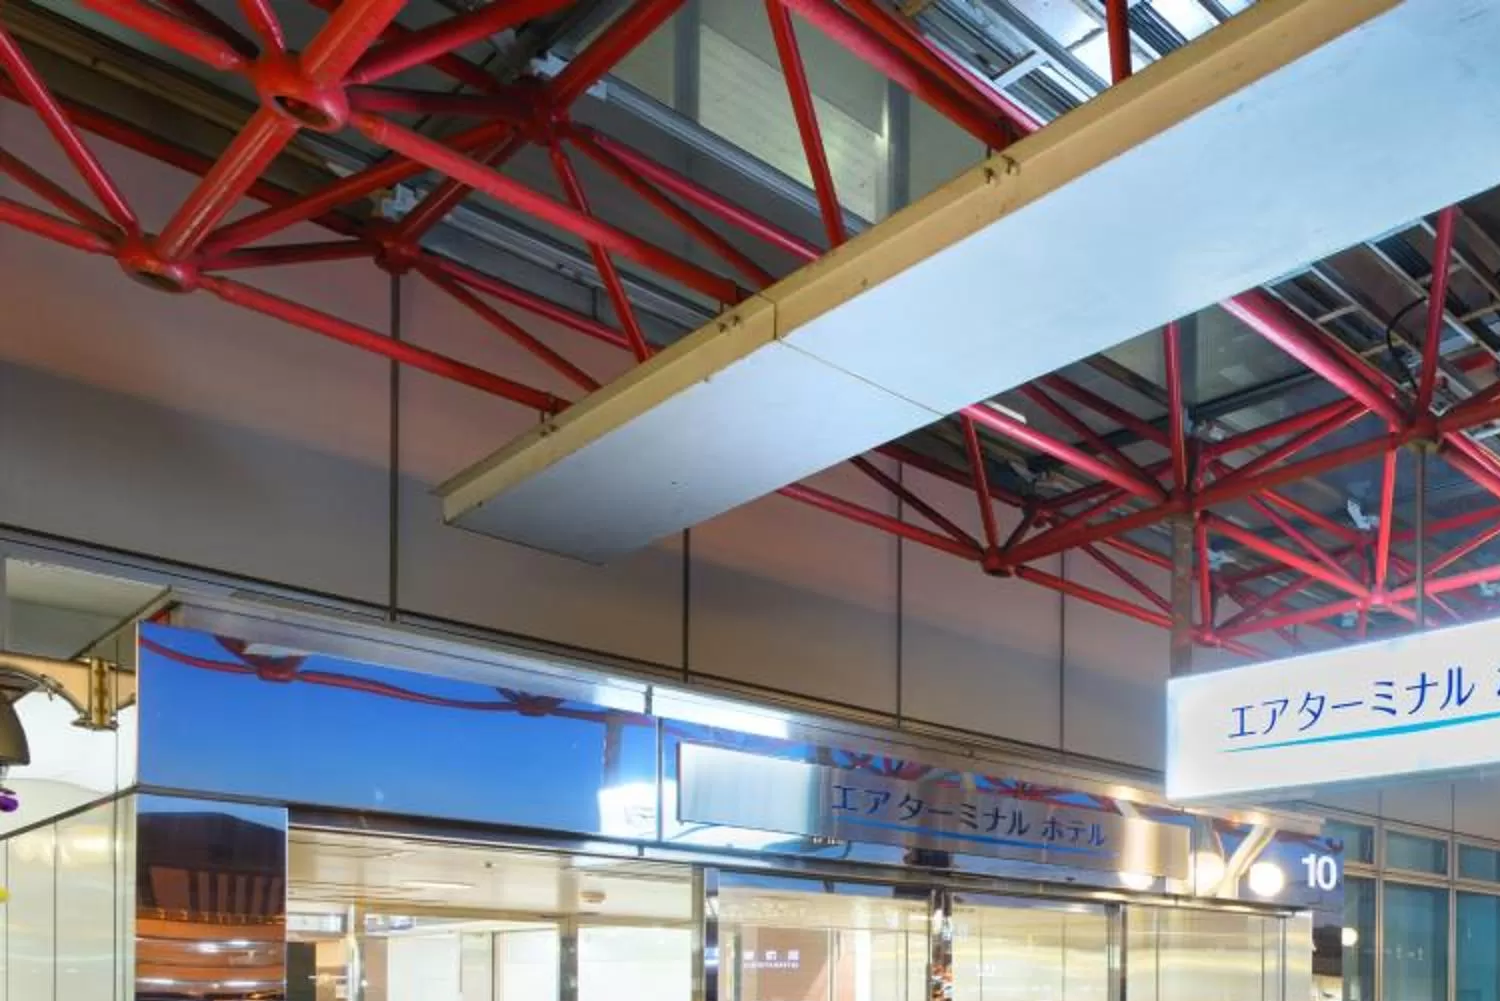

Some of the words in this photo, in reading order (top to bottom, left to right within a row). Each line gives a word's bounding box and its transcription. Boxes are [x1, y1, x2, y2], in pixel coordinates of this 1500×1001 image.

[1228, 665, 1475, 739] エアターミナル
[831, 784, 1030, 838] エアターミナル
[1042, 817, 1106, 847] ホテル
[1301, 854, 1338, 891] 10
